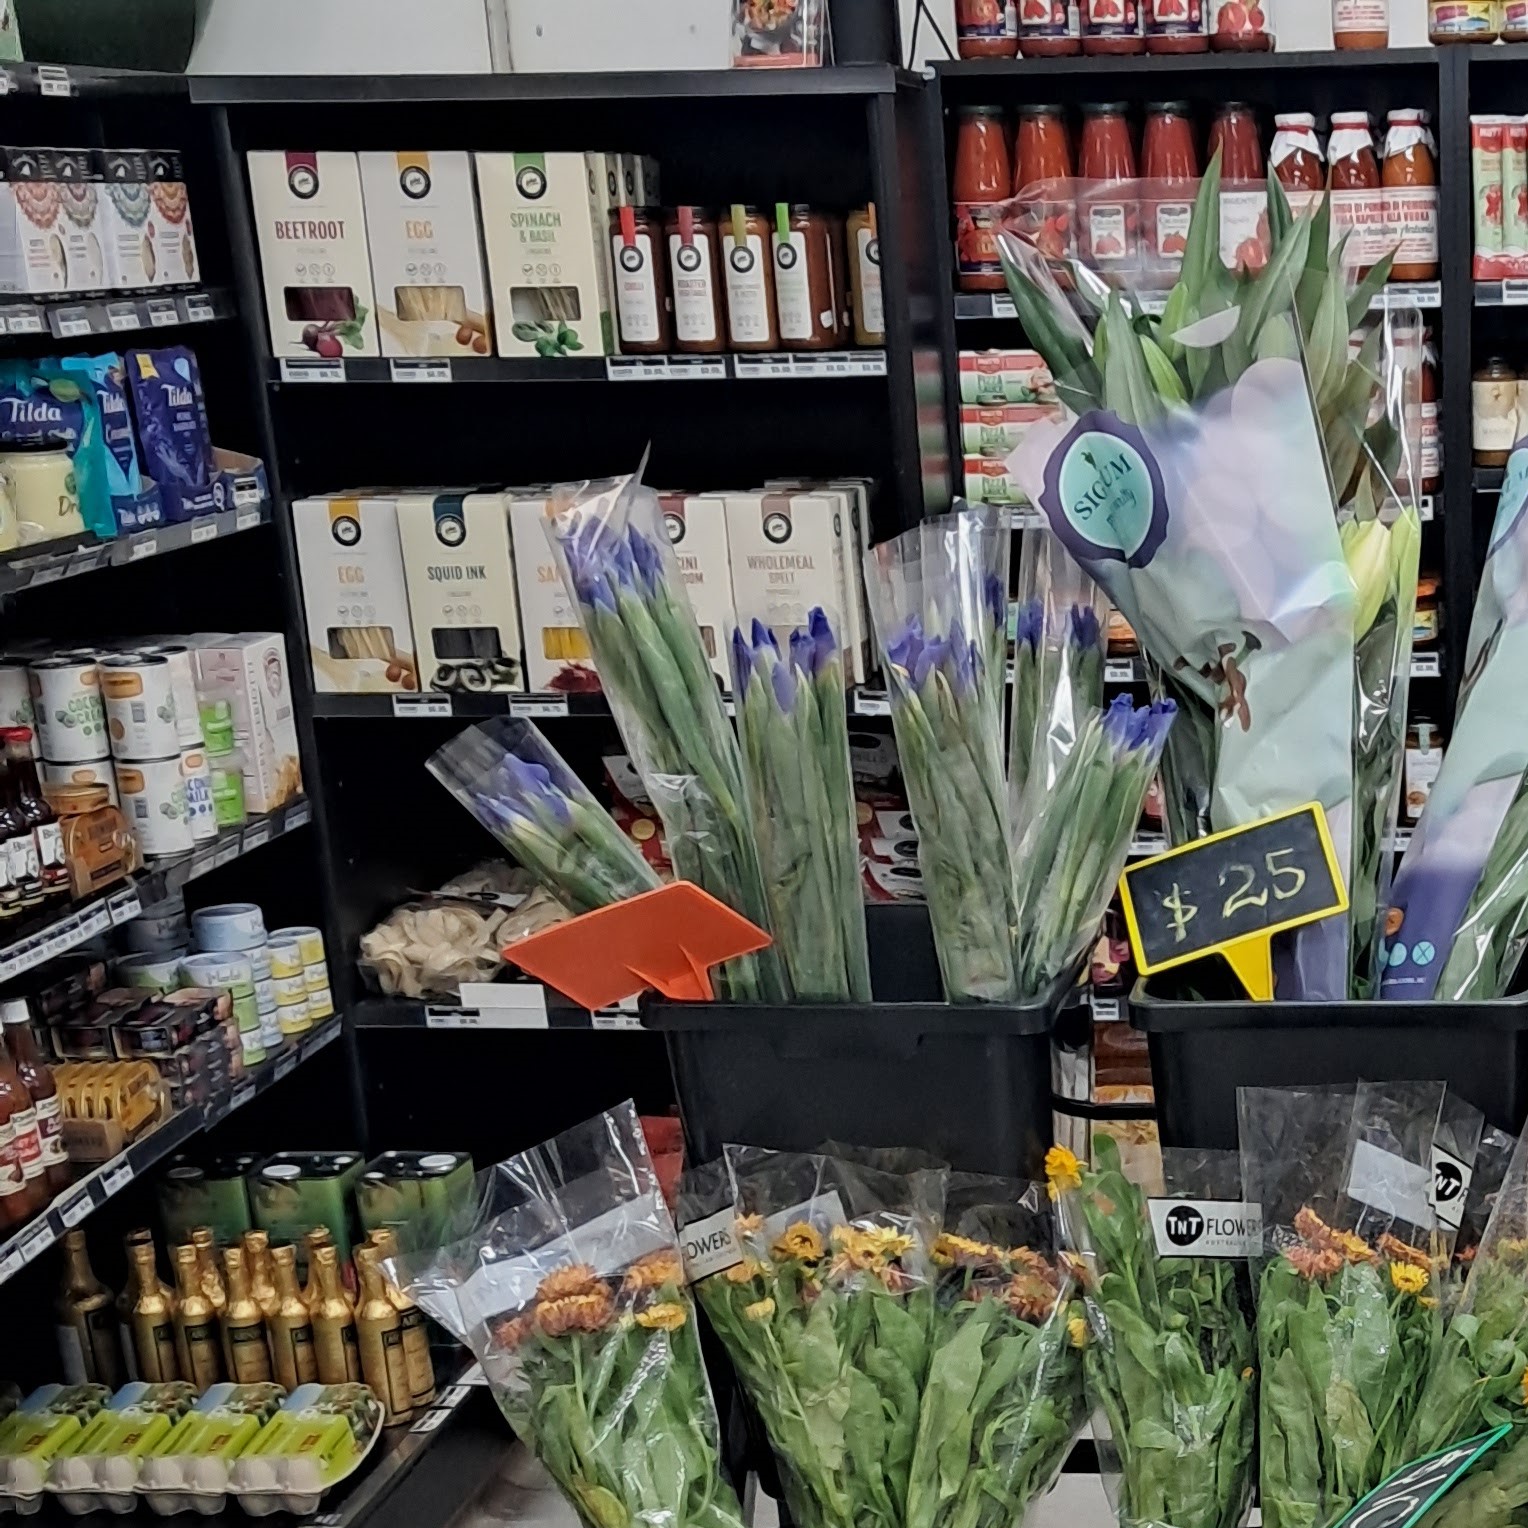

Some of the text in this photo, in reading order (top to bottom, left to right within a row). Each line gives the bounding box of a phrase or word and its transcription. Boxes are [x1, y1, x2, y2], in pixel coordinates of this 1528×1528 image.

[510, 212, 562, 228] SPINACH
[274, 220, 346, 241] BEETROOT
[406, 221, 434, 240] EGG
[161, 384, 193, 407] Tilda
[1, 397, 63, 423] Tilda
[746, 555, 815, 570] WHOLEMEAL
[337, 565, 365, 584] EGG
[427, 564, 487, 583] SQUID INK
[1161, 847, 1306, 943] $25
